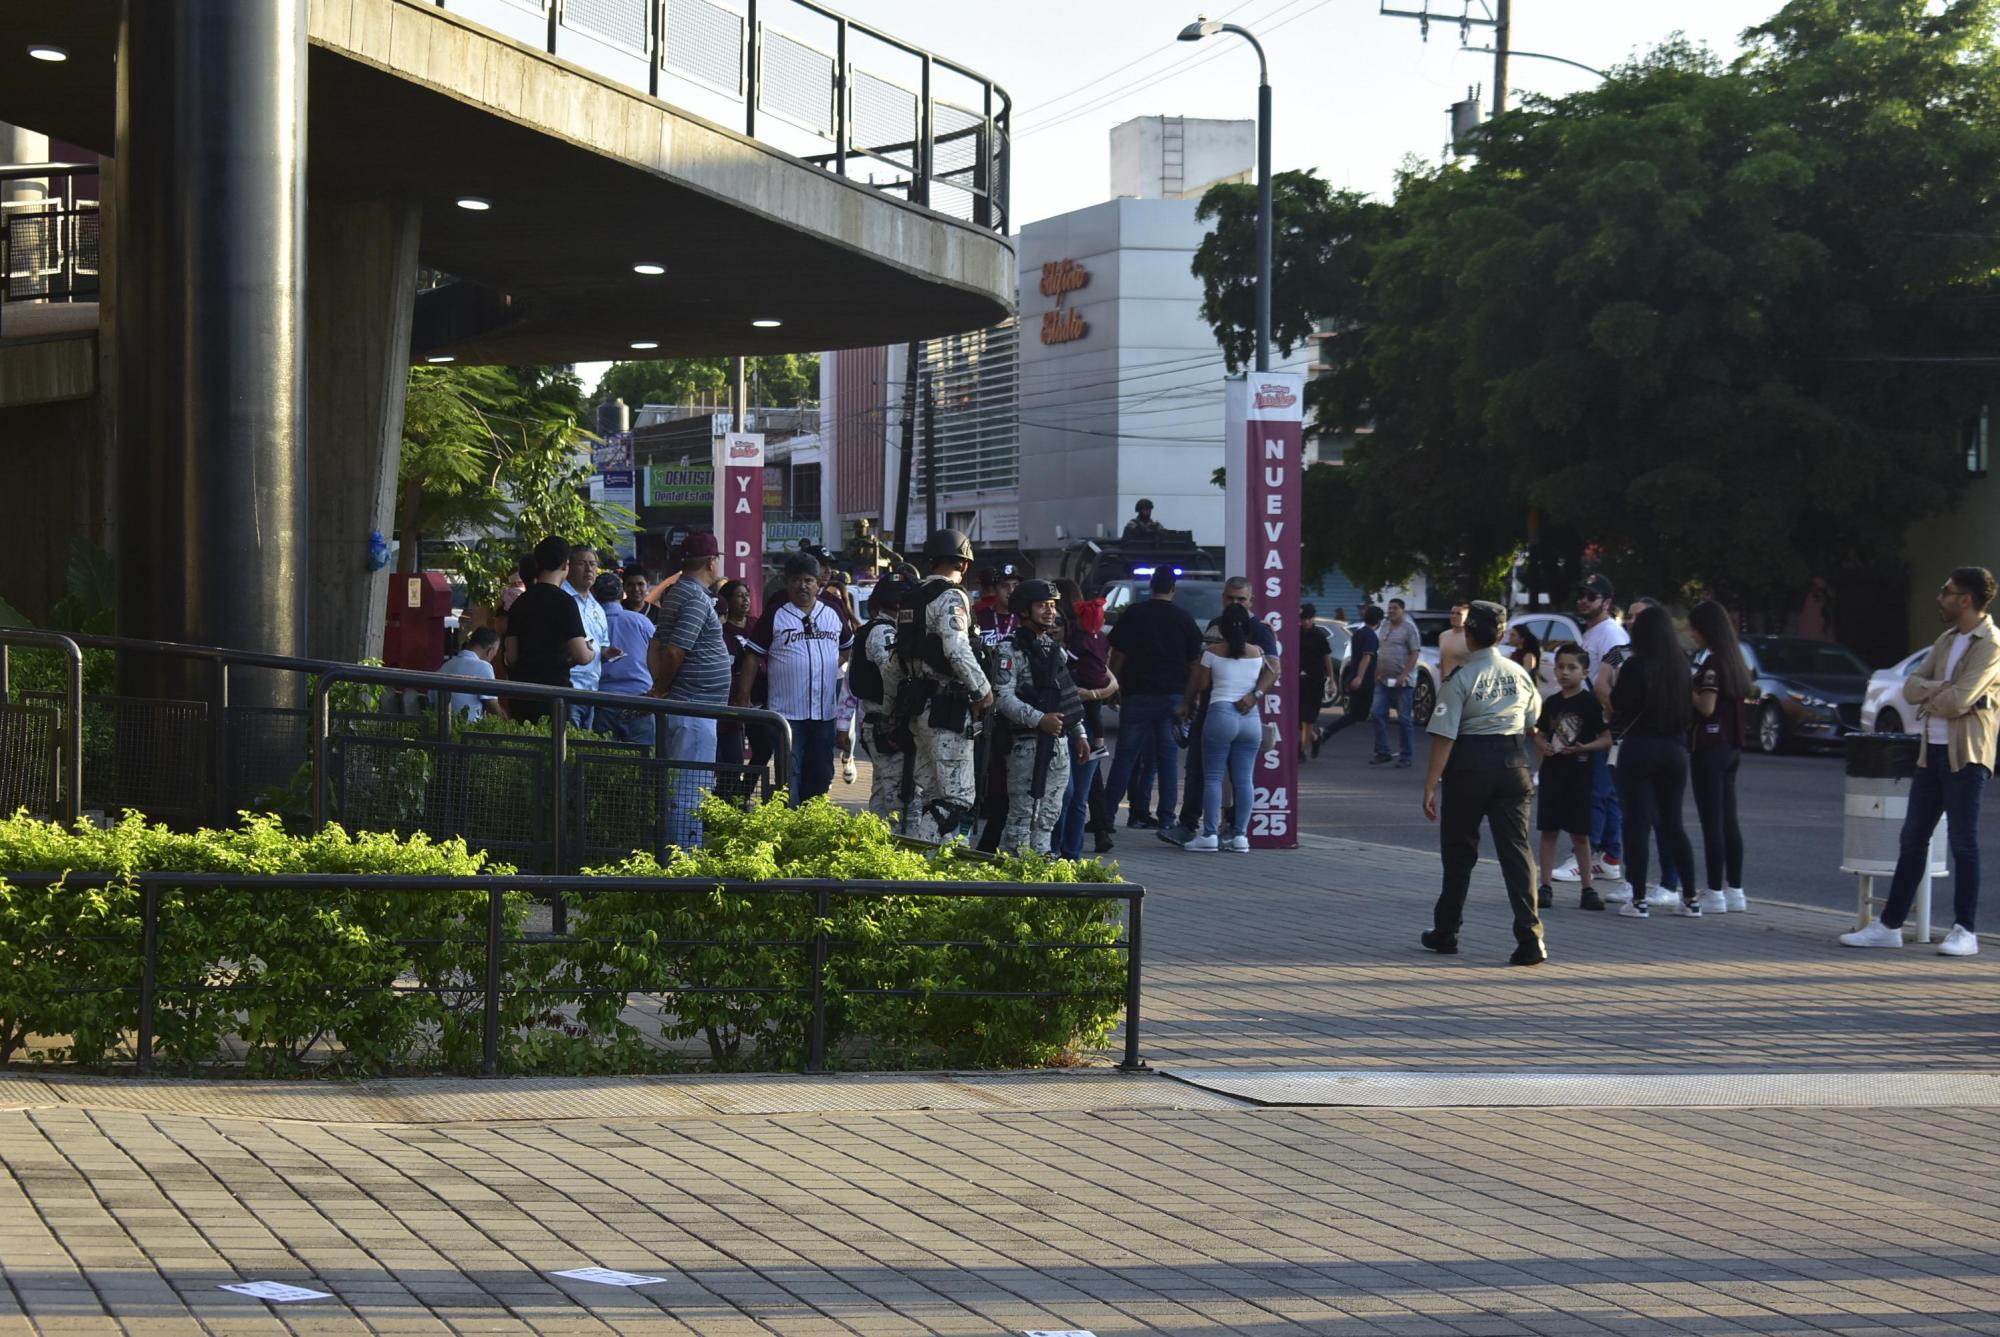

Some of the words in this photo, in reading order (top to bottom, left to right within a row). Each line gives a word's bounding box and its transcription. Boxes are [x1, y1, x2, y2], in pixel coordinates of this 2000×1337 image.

[735, 475, 752, 514] YA
[1264, 439, 1284, 598] NUEVAS
[1263, 610, 1284, 770] GRAS
[1477, 674, 1517, 689] GUARD
[1475, 686, 1519, 702] NACION
[1253, 787, 1289, 810] 24
[1252, 814, 1288, 837] 25
